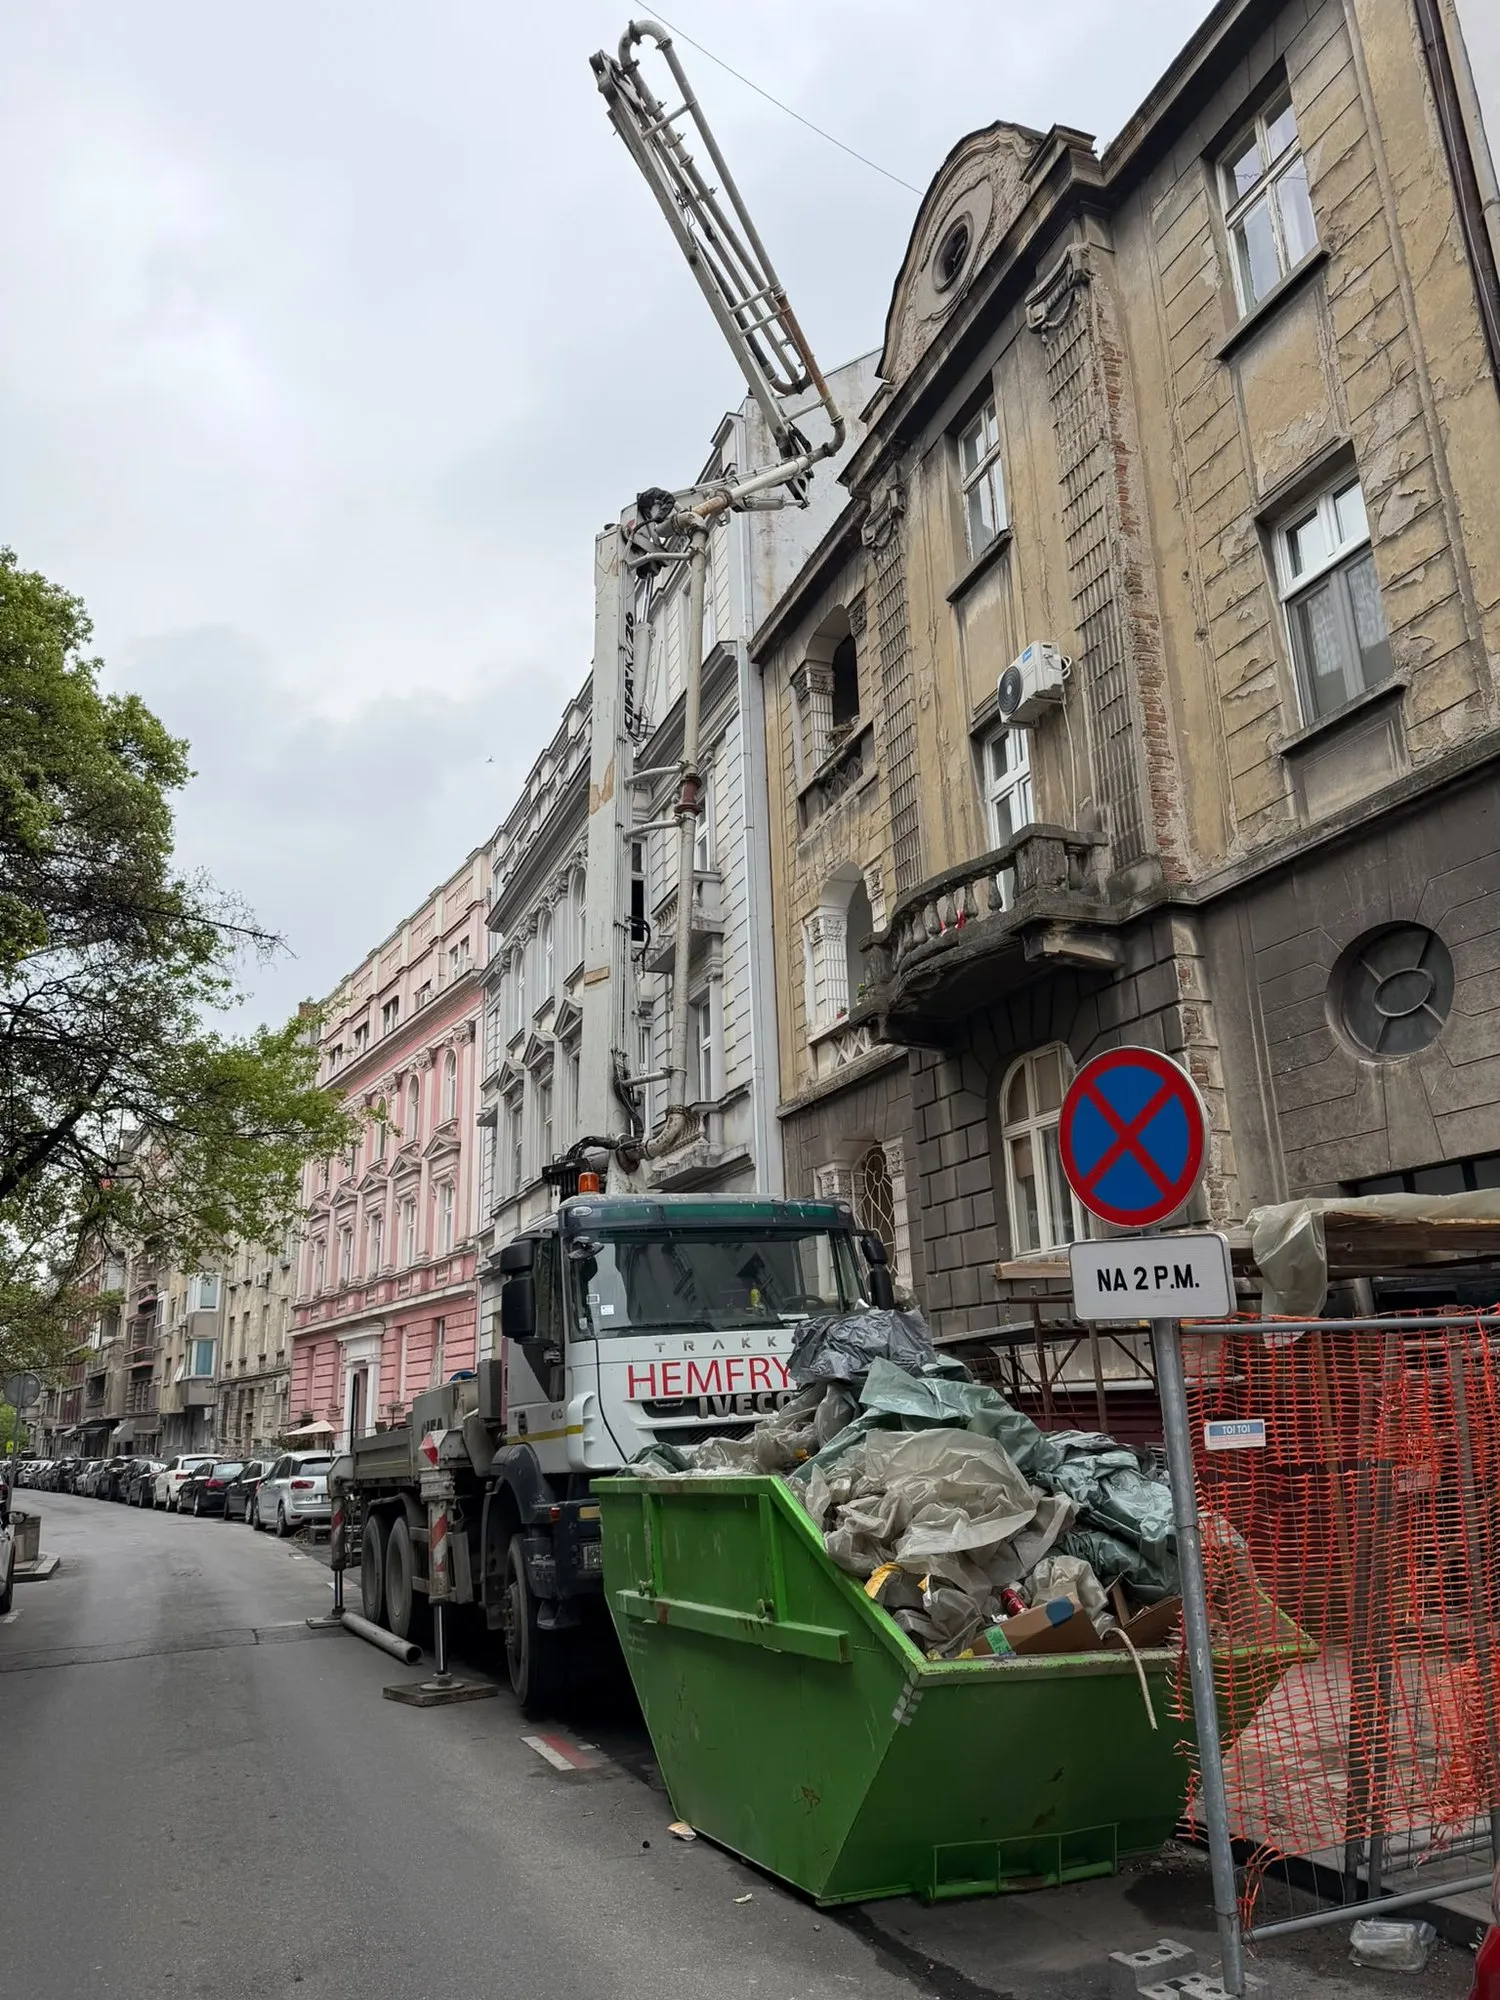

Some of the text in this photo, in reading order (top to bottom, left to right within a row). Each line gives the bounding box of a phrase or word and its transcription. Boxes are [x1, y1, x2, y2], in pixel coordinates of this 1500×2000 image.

[1097, 1263, 1200, 1292] NA 2 P.M.
[654, 1336, 778, 1353] TRAKK
[627, 1356, 790, 1399] HEMFRY
[699, 1391, 795, 1419] IVECO
[1222, 1424, 1251, 1435] TOI TOI
